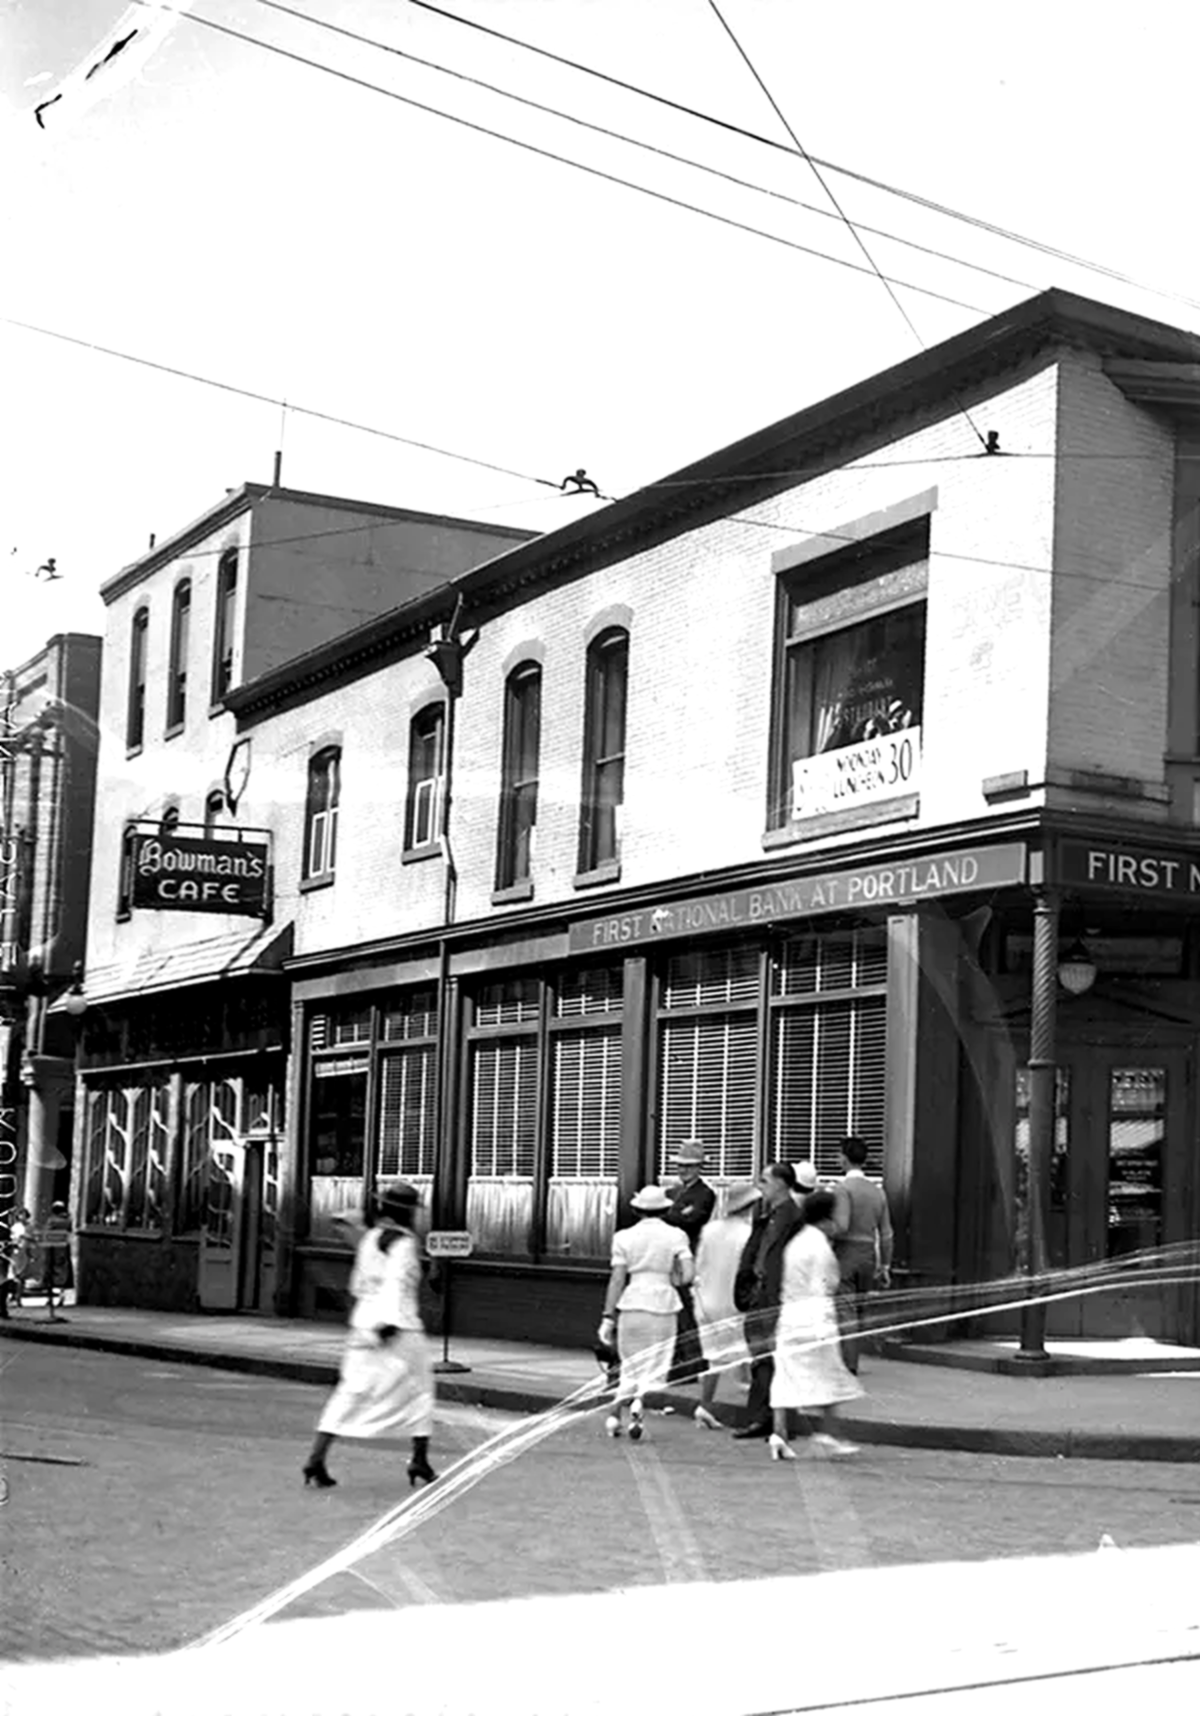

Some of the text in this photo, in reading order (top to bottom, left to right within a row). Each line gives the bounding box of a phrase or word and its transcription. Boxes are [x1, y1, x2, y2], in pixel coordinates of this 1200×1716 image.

[138, 838, 264, 878] Bowman's
[1087, 851, 1180, 890] FIRST
[157, 878, 240, 903] CAFE
[592, 857, 980, 946] FIRST NATIONAL BANK AT PORTLAND
